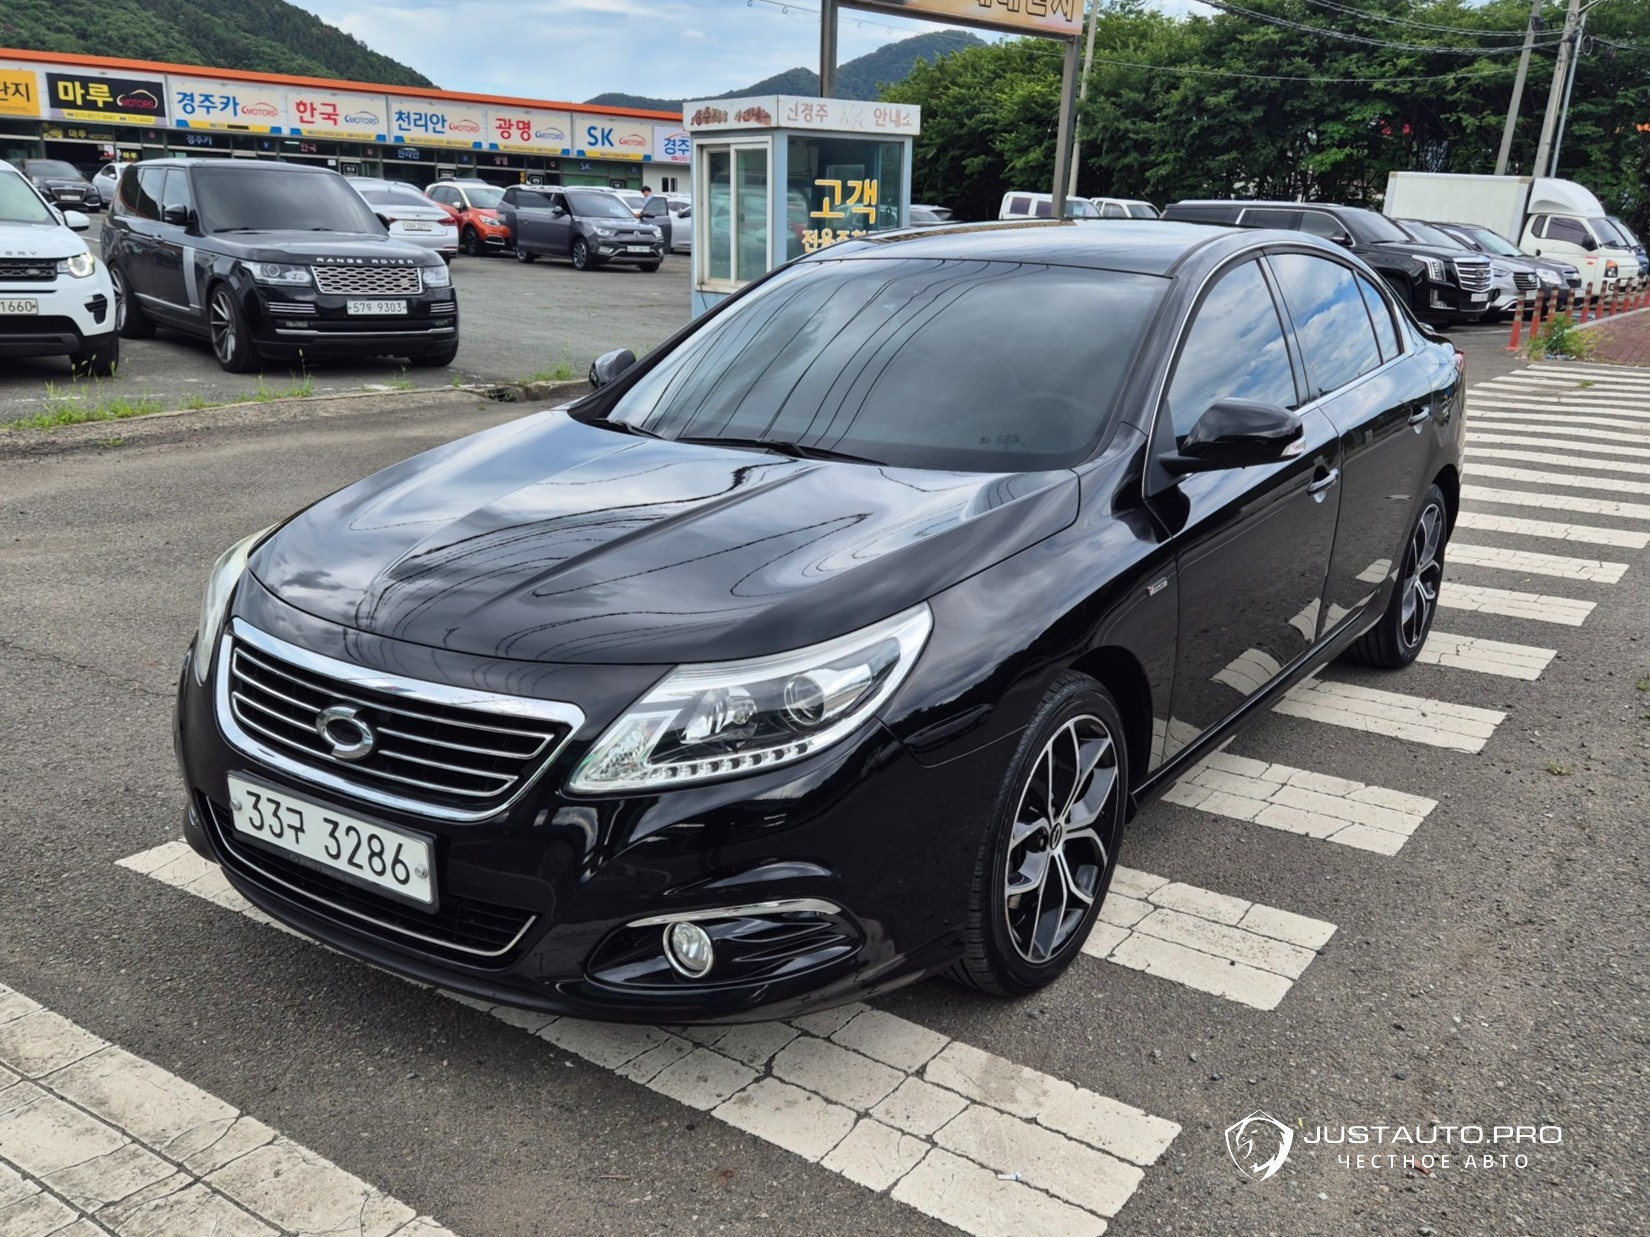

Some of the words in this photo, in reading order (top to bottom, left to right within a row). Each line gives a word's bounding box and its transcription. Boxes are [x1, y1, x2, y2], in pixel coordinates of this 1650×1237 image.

[57, 81, 114, 108] 마루
[121, 98, 155, 110] MOTORS
[176, 92, 240, 117] 경주카
[245, 108, 277, 117] MOTORS
[295, 100, 340, 126] 한국
[348, 116, 378, 126] MOTORS
[395, 110, 447, 134] 천리안
[452, 124, 479, 133] MOTORS
[787, 101, 829, 123] 신경주
[873, 107, 913, 128] 안내소
[495, 118, 531, 142] 광명
[587, 125, 614, 148] SK
[810, 179, 878, 224] 고객
[377, 302, 402, 313] 9303
[246, 789, 306, 845] 33구
[322, 817, 410, 886] 3286
